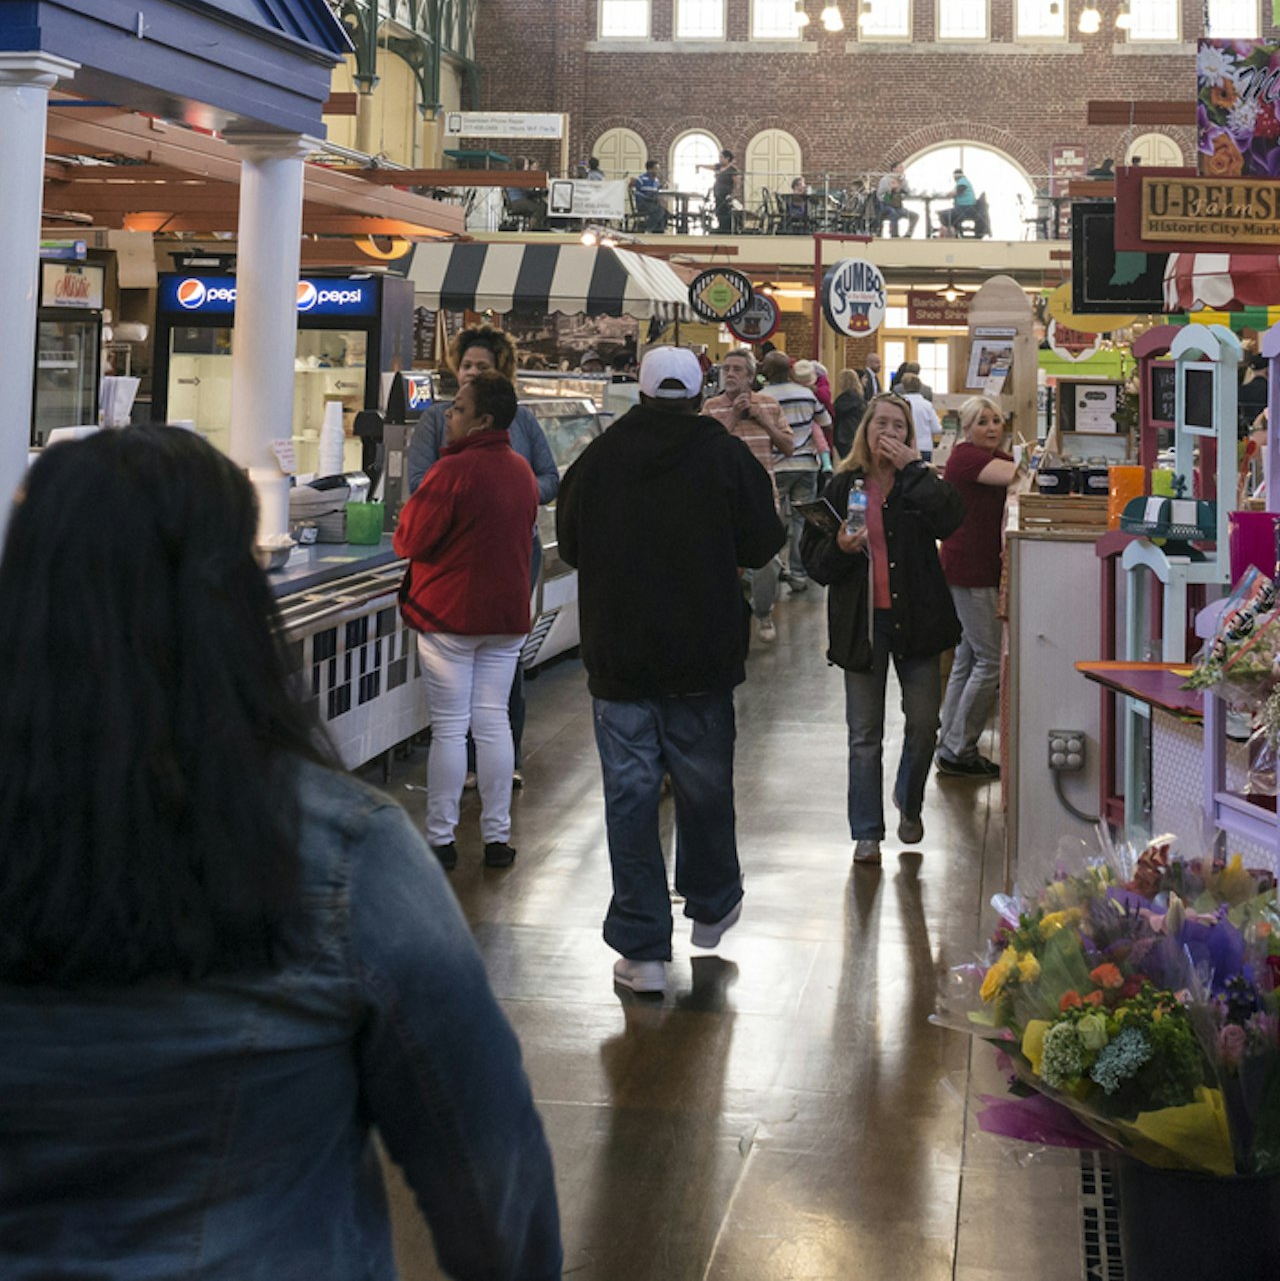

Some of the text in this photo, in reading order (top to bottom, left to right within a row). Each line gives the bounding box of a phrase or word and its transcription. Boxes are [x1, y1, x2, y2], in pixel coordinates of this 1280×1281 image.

[1148, 220, 1208, 233] Historic
[1210, 221, 1240, 237] City
[206, 287, 237, 303] pep
[317, 288, 362, 305] pepsi
[948, 298, 969, 308] Sho
[915, 309, 942, 320] Shoe
